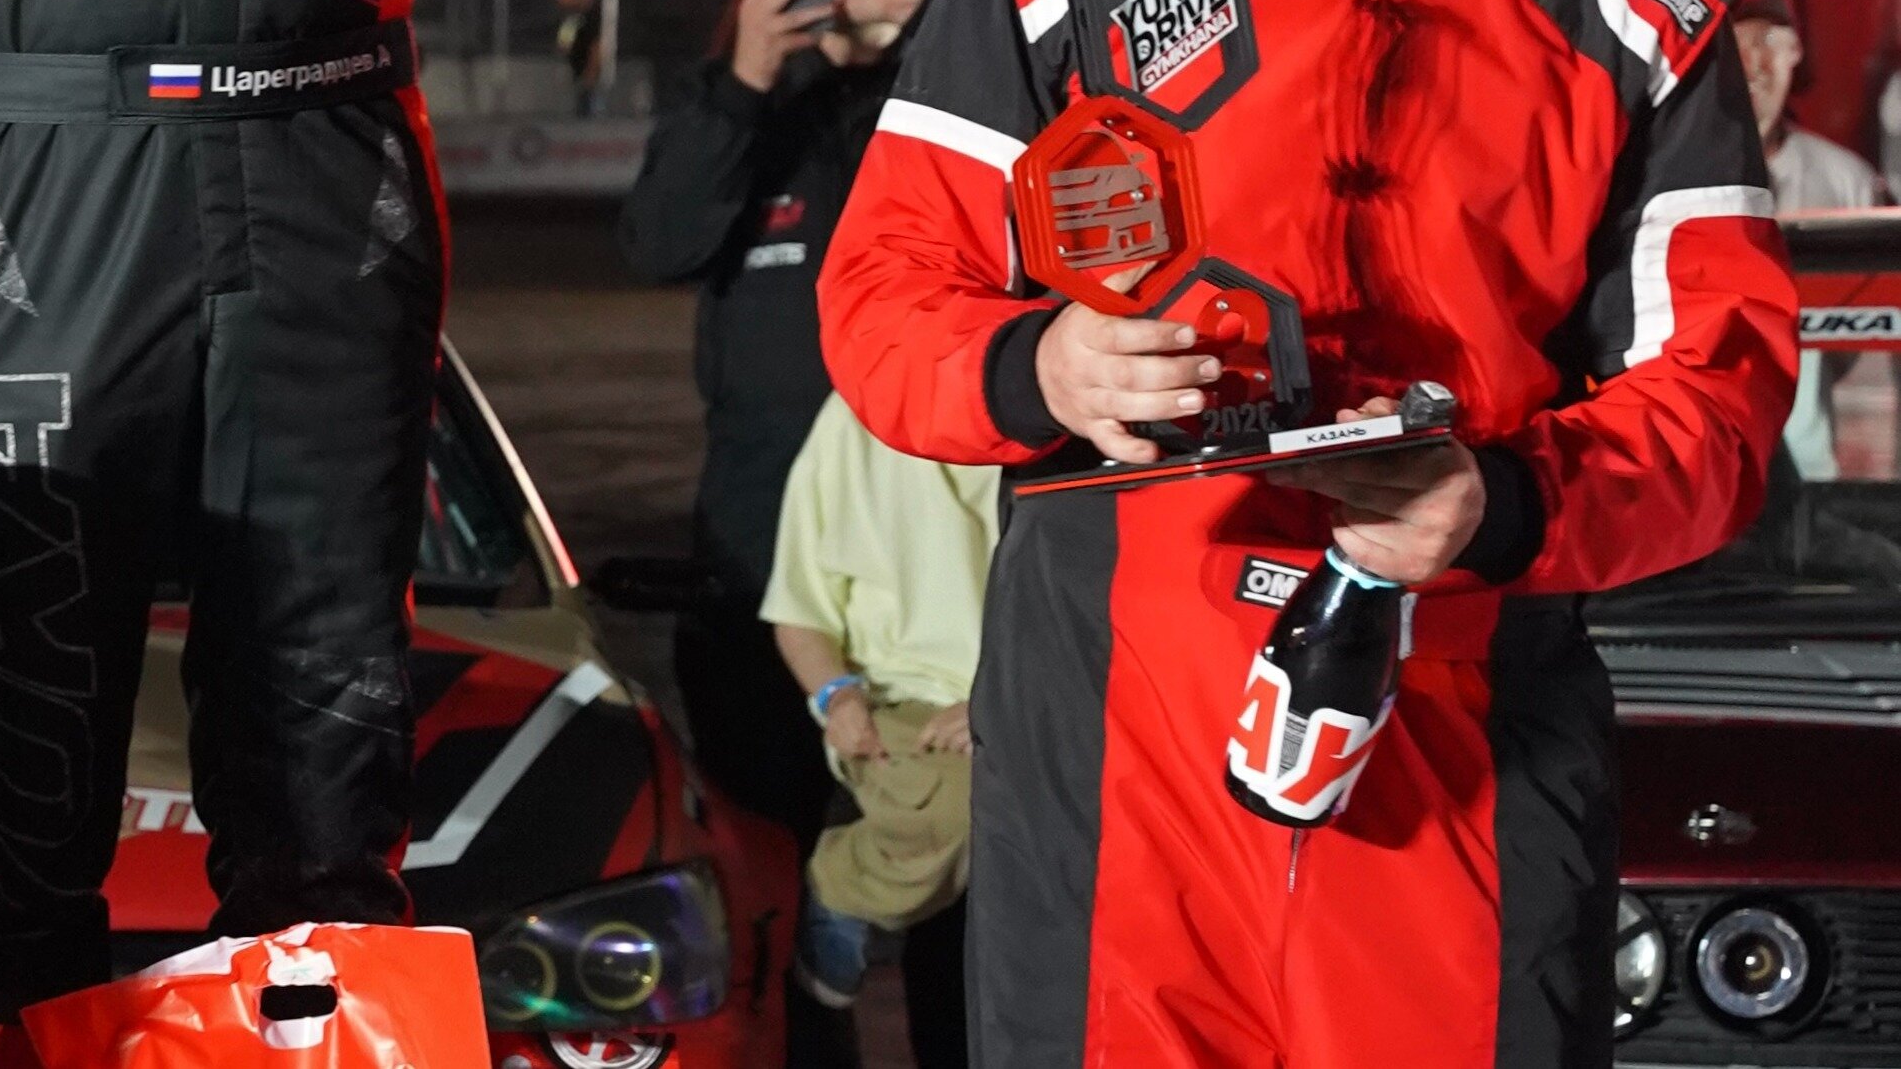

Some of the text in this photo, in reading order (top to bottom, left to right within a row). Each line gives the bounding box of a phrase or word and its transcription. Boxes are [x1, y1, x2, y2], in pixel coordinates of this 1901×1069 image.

[1140, 10, 1232, 87] GYMKHANA
[1800, 313, 1892, 333] UKA
[1306, 426, 1367, 444] КАЗАНЬ
[1246, 568, 1300, 599] OM
